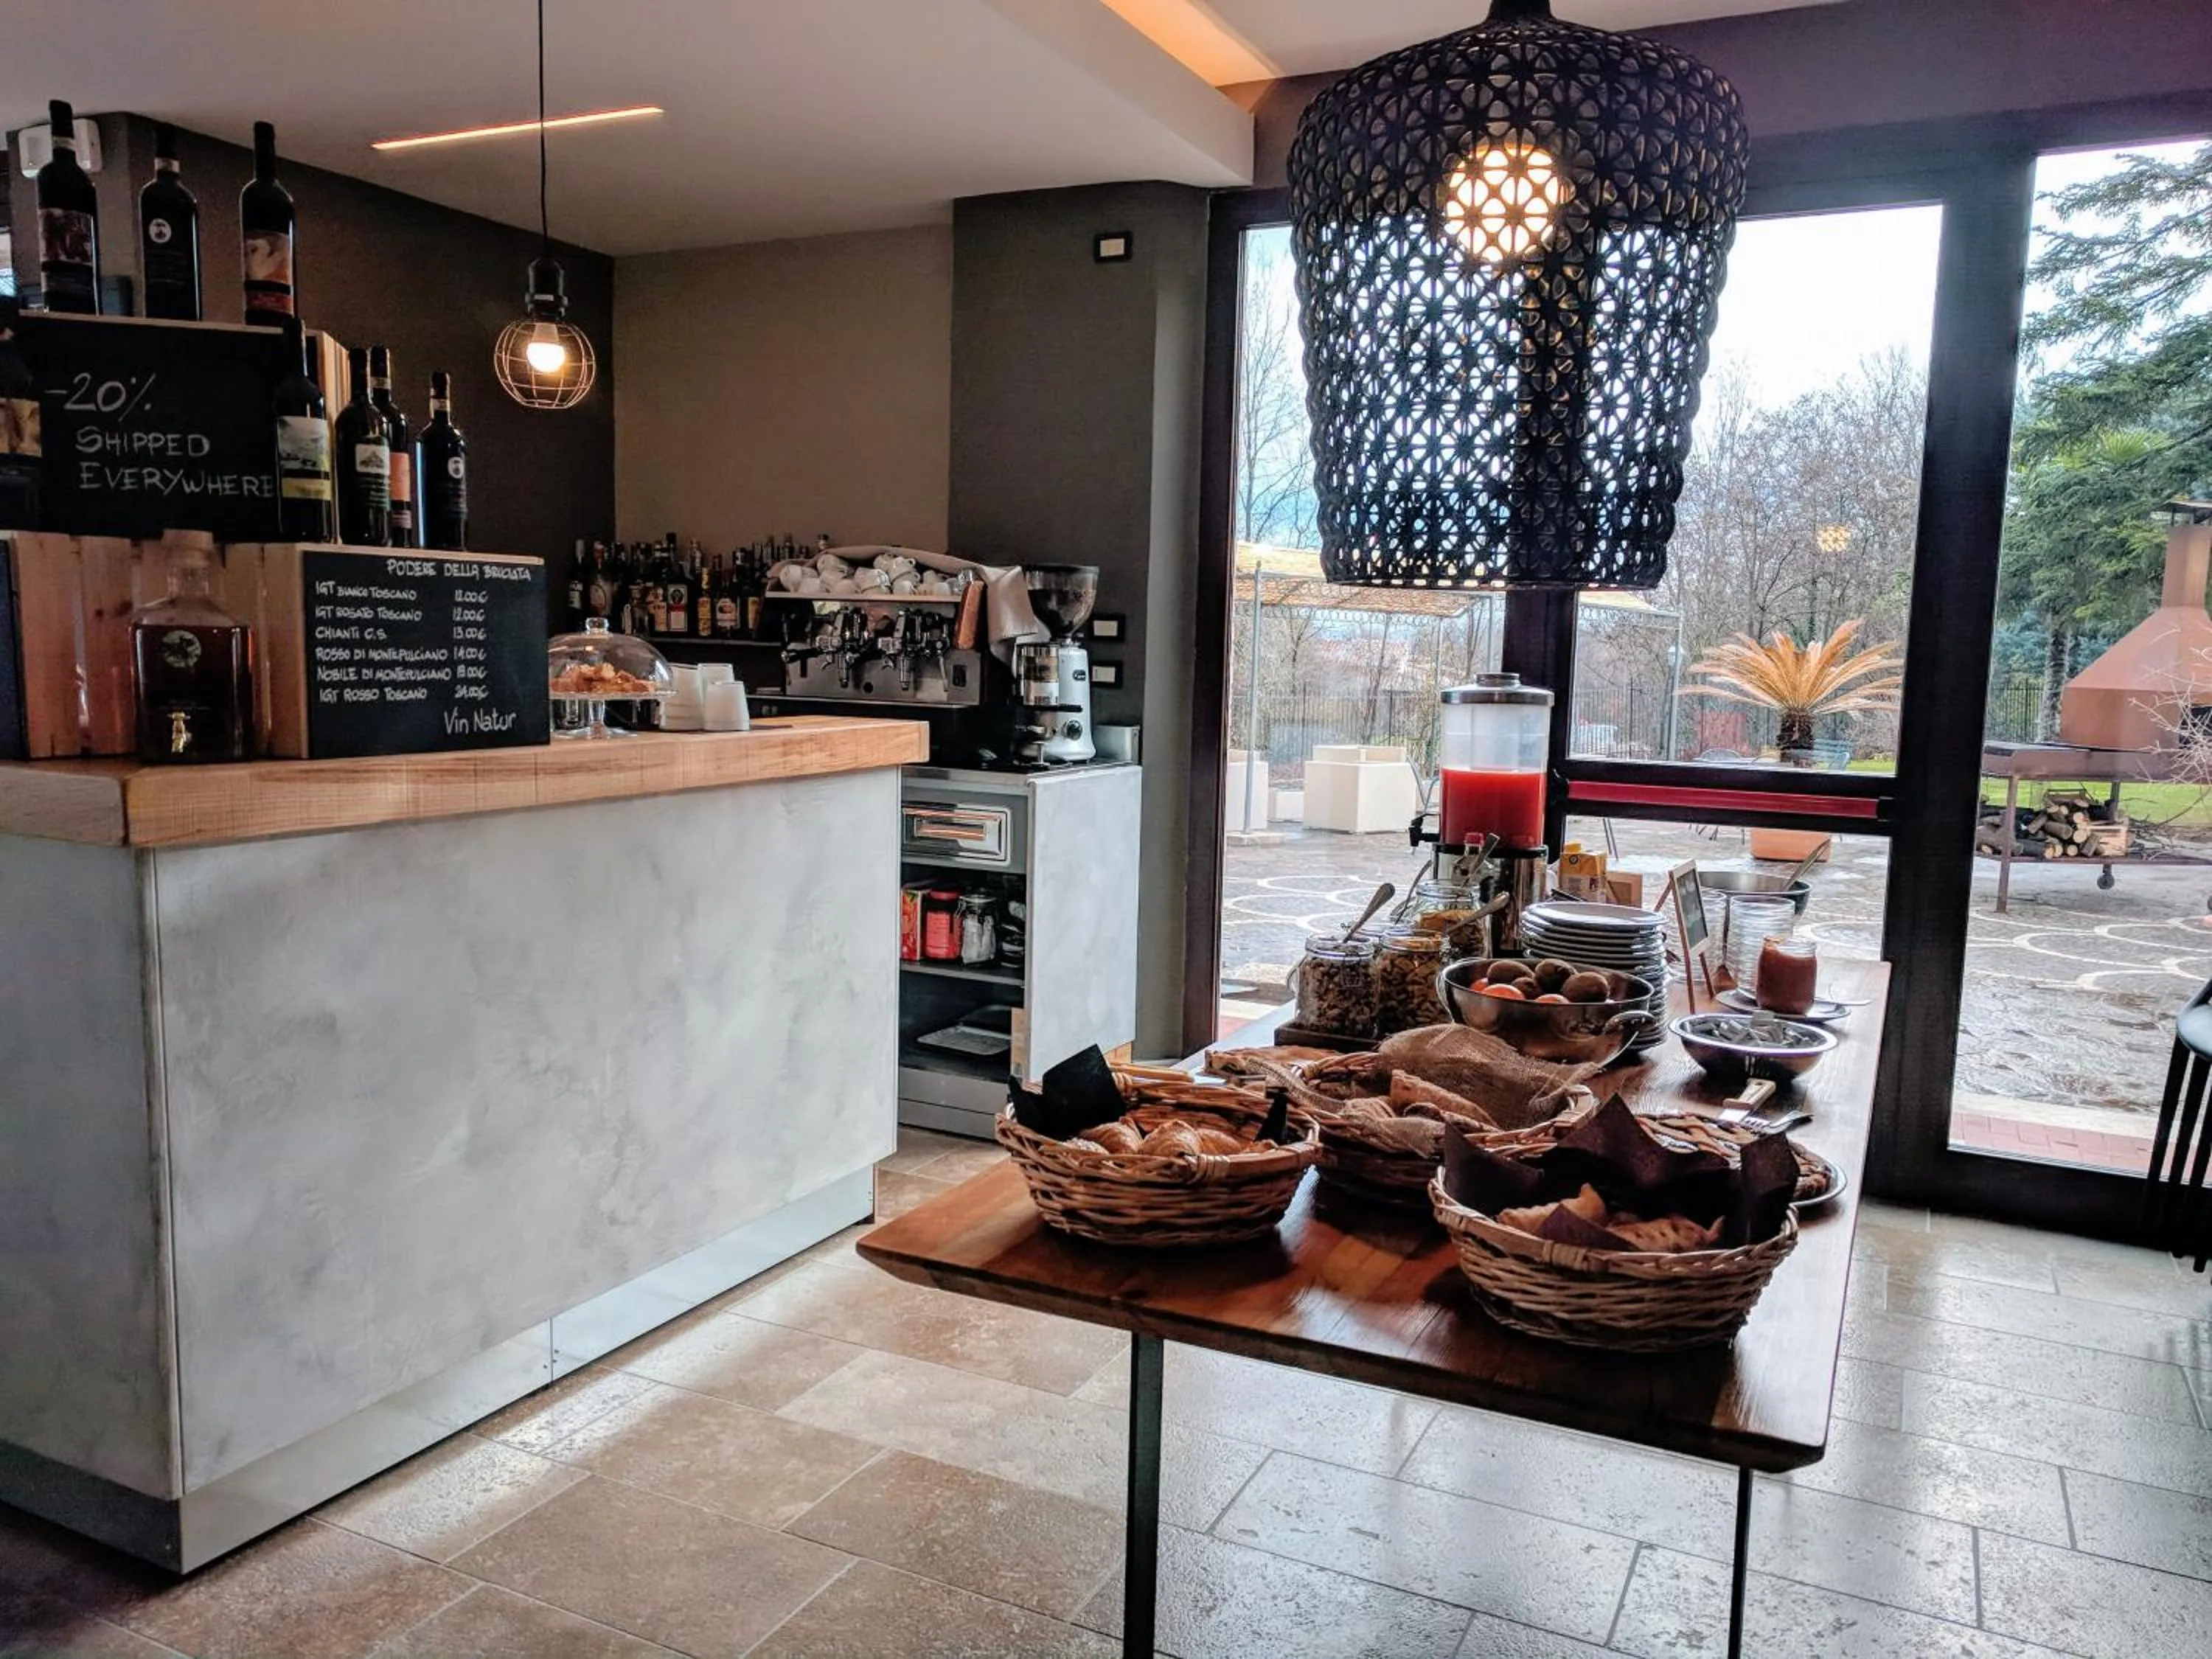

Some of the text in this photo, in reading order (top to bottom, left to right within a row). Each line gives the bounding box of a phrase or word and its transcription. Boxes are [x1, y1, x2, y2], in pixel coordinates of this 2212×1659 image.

[75, 425, 212, 456] SHIPPED
[79, 462, 274, 498] EVERYWHERE
[386, 558, 437, 577] PODERE
[444, 563, 479, 580] DELLA
[315, 580, 335, 596] IGT
[369, 586, 417, 601] TOSCANO
[315, 605, 334, 619] IGT
[377, 605, 423, 622] TOSCANO
[315, 647, 351, 662] ROSSO
[353, 647, 366, 661] DI
[316, 665, 358, 682] NOBILE
[361, 667, 374, 681] DI
[319, 687, 340, 704] IGT
[343, 688, 380, 703] ROSSO
[383, 686, 428, 702] TOSCANO
[444, 706, 516, 734] Vin Natur
